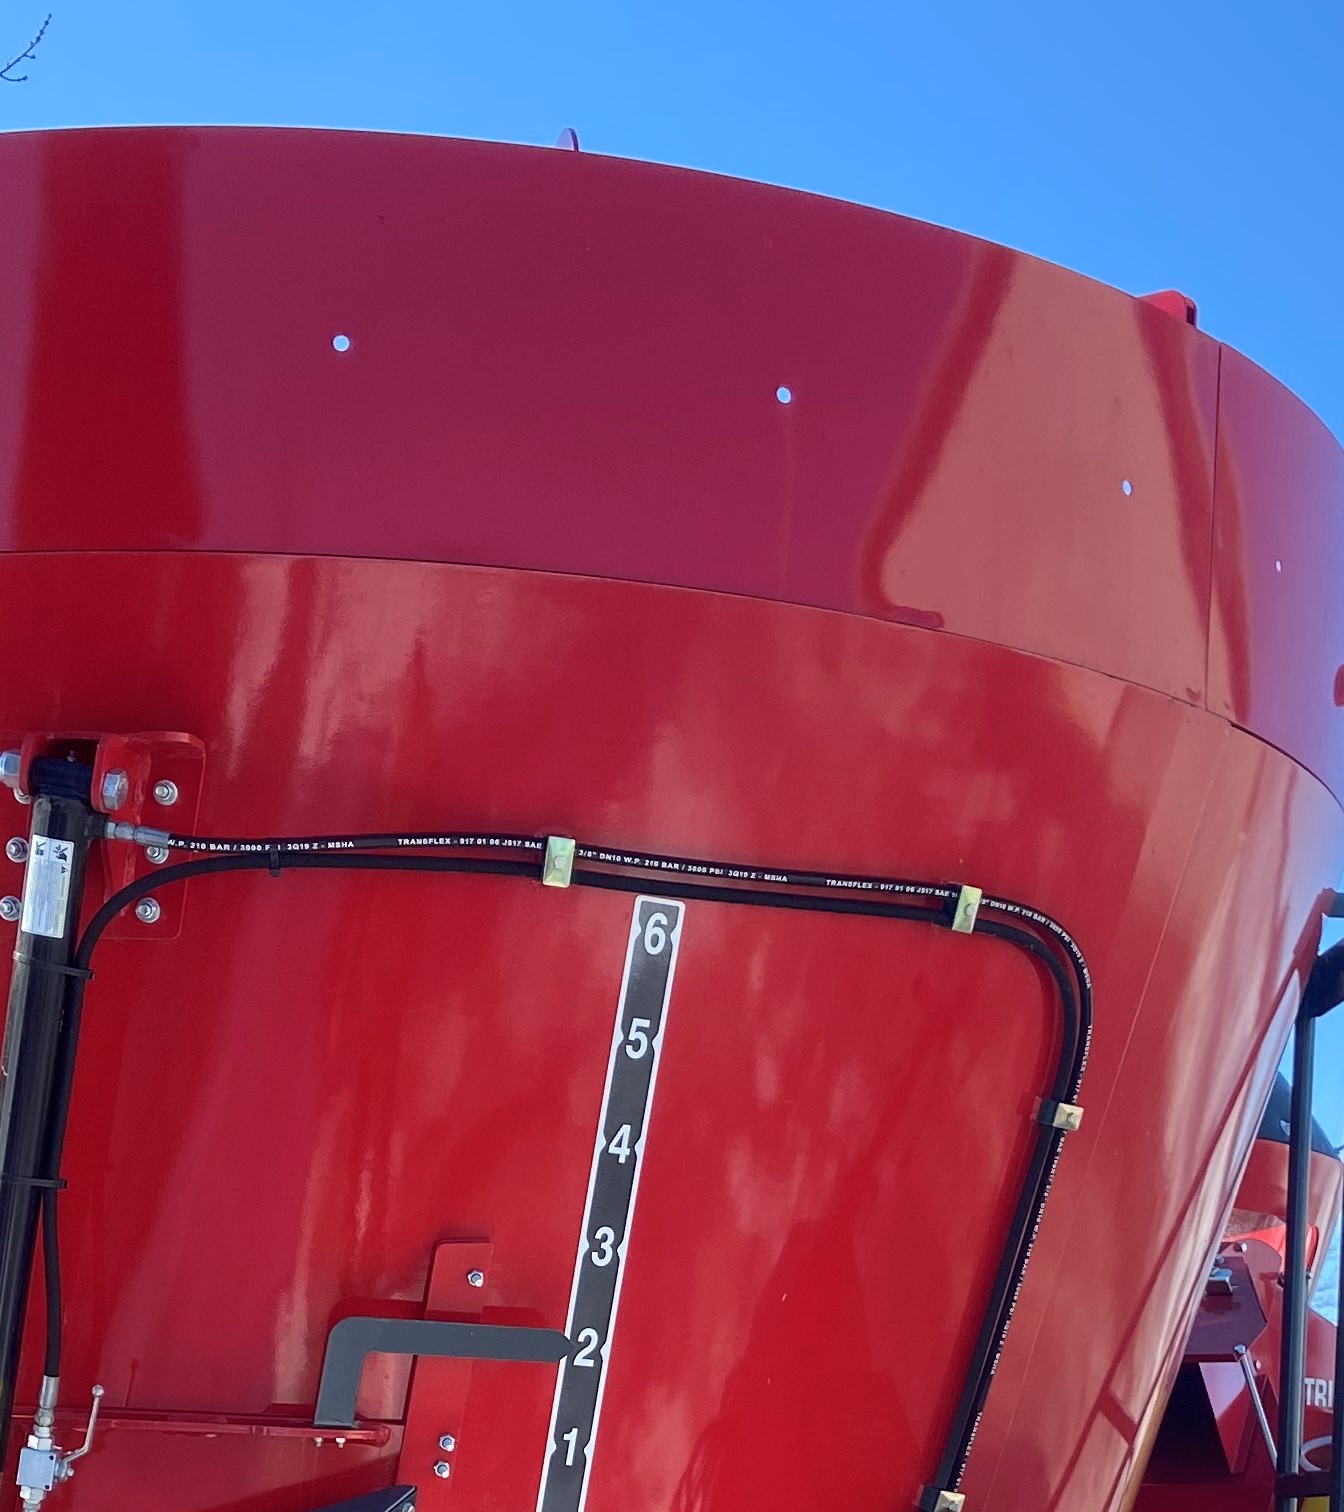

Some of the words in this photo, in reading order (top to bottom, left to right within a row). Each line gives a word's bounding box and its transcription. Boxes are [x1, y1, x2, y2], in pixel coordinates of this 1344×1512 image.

[209, 843, 231, 851] BAR
[328, 841, 354, 849] MSHA
[398, 838, 451, 846] TRANSFLEX
[524, 841, 543, 849] SAE
[599, 853, 621, 862] DN10
[661, 861, 680, 870] BAR
[764, 873, 788, 882] MSHA
[826, 879, 872, 890] TRANSFLEX
[643, 912, 667, 955] 6
[625, 1018, 651, 1060] 5
[608, 1124, 632, 1164] 4
[591, 1226, 614, 1267] 3
[573, 1327, 599, 1367] 2
[562, 1427, 580, 1466] 1
